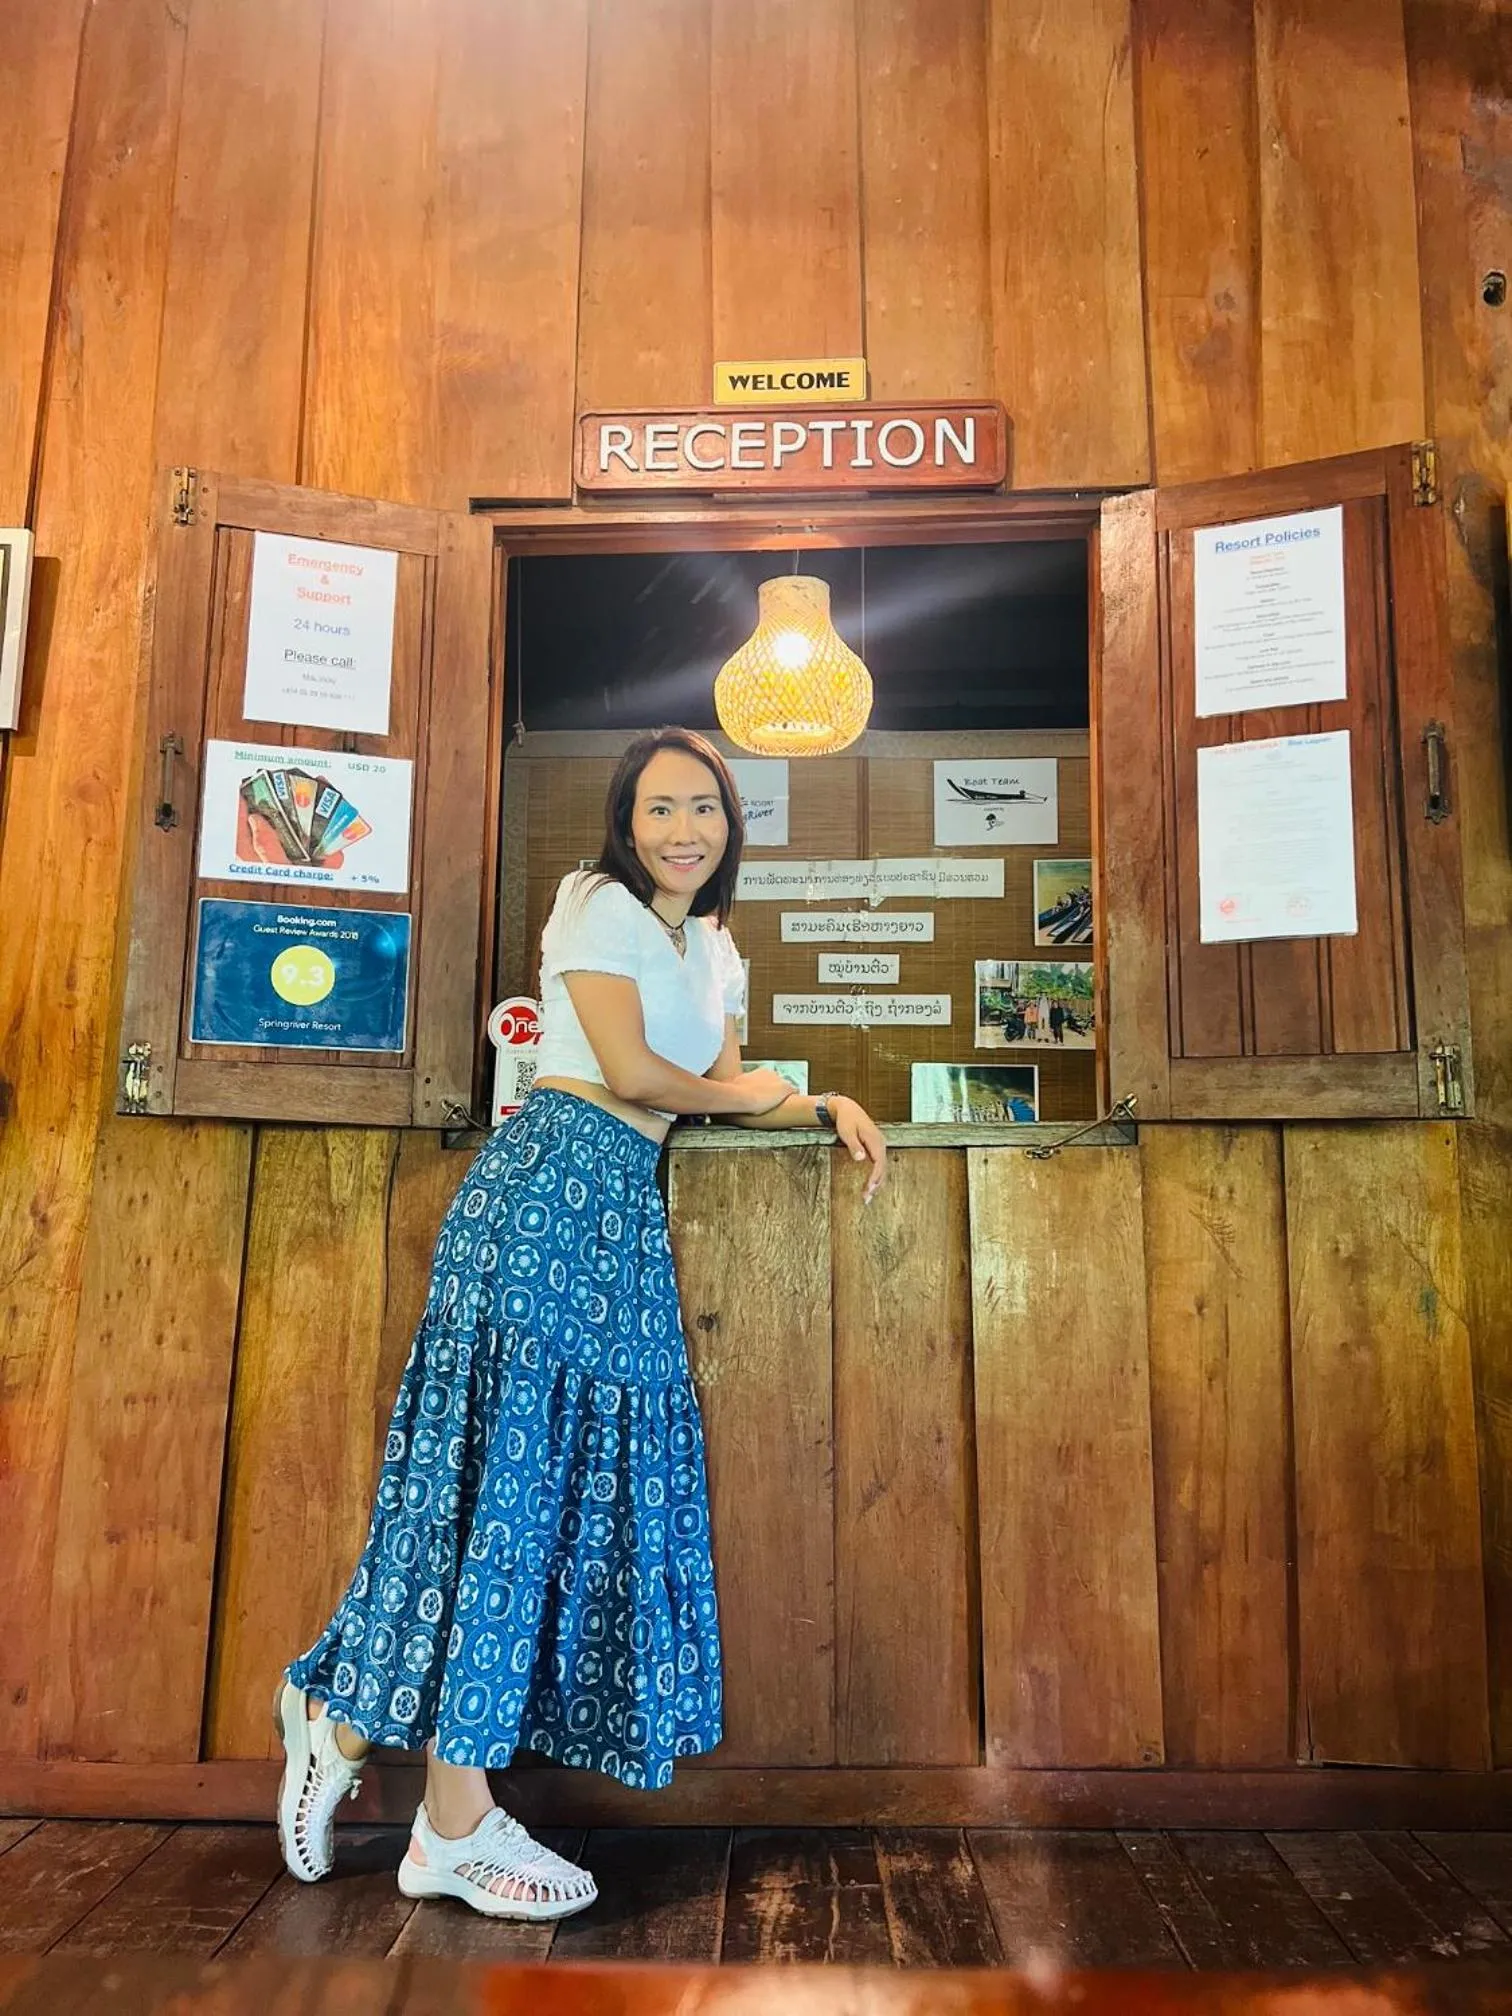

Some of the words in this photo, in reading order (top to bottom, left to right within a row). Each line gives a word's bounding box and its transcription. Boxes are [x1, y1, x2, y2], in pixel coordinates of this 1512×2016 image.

[728, 371, 851, 391] WELCOME
[599, 416, 976, 472] RECEPTION
[1214, 536, 1260, 554] Resort
[1265, 527, 1321, 546] Policies
[287, 553, 365, 577] Emergency
[320, 575, 330, 586] &
[296, 586, 353, 607] Support
[293, 617, 310, 631] 24
[313, 617, 351, 636] hours
[283, 648, 328, 665] Please
[234, 750, 285, 764] Minimum
[348, 762, 370, 773] USD
[373, 765, 387, 774] 20
[964, 777, 988, 786] Boat
[991, 777, 1021, 786] Team
[321, 790, 338, 814] VISA
[229, 863, 262, 876] Credit
[265, 866, 290, 878] Card
[276, 914, 337, 928] Booking.com
[253, 924, 278, 934] Guest
[279, 926, 308, 936] Review
[309, 928, 339, 939] Awards
[280, 963, 325, 987] 9.3
[258, 1016, 310, 1032] Springriver
[312, 1020, 342, 1032] Resort
